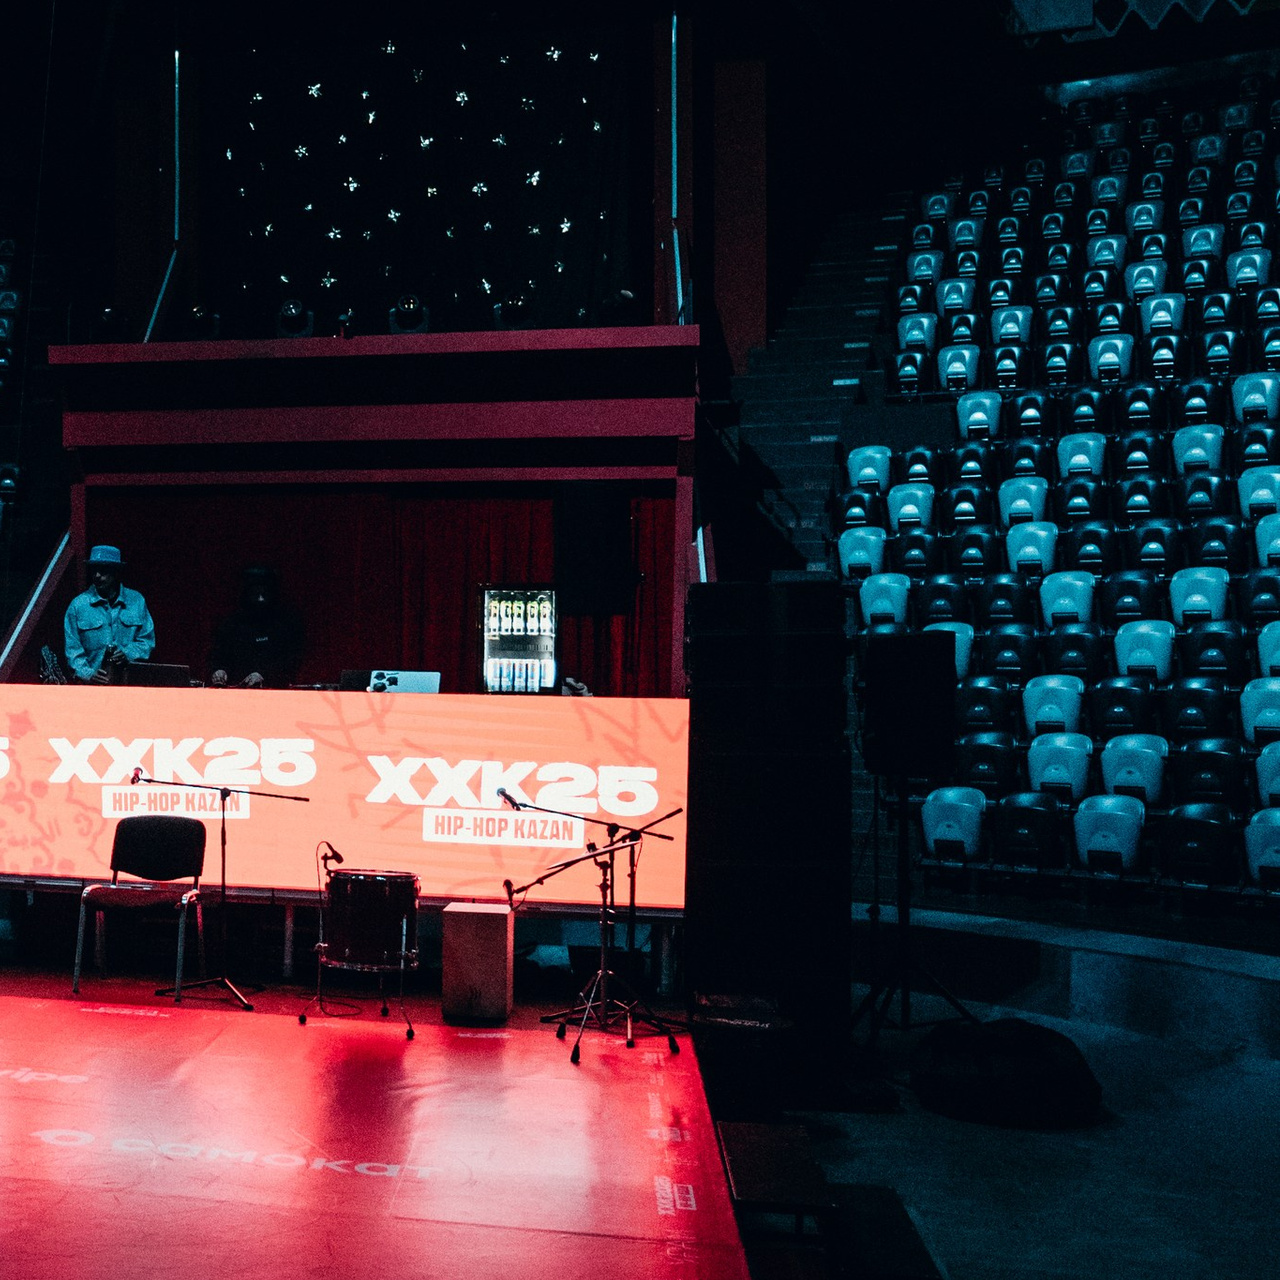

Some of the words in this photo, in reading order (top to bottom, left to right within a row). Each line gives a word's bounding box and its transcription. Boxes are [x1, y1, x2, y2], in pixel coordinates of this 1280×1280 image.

[48, 736, 317, 786] XXK25
[112, 792, 180, 812] HIP-HOP
[185, 792, 240, 812] KAZAN
[365, 755, 659, 817] XXK25
[434, 814, 508, 838] HIP-HOP
[514, 817, 573, 841] KAZAN
